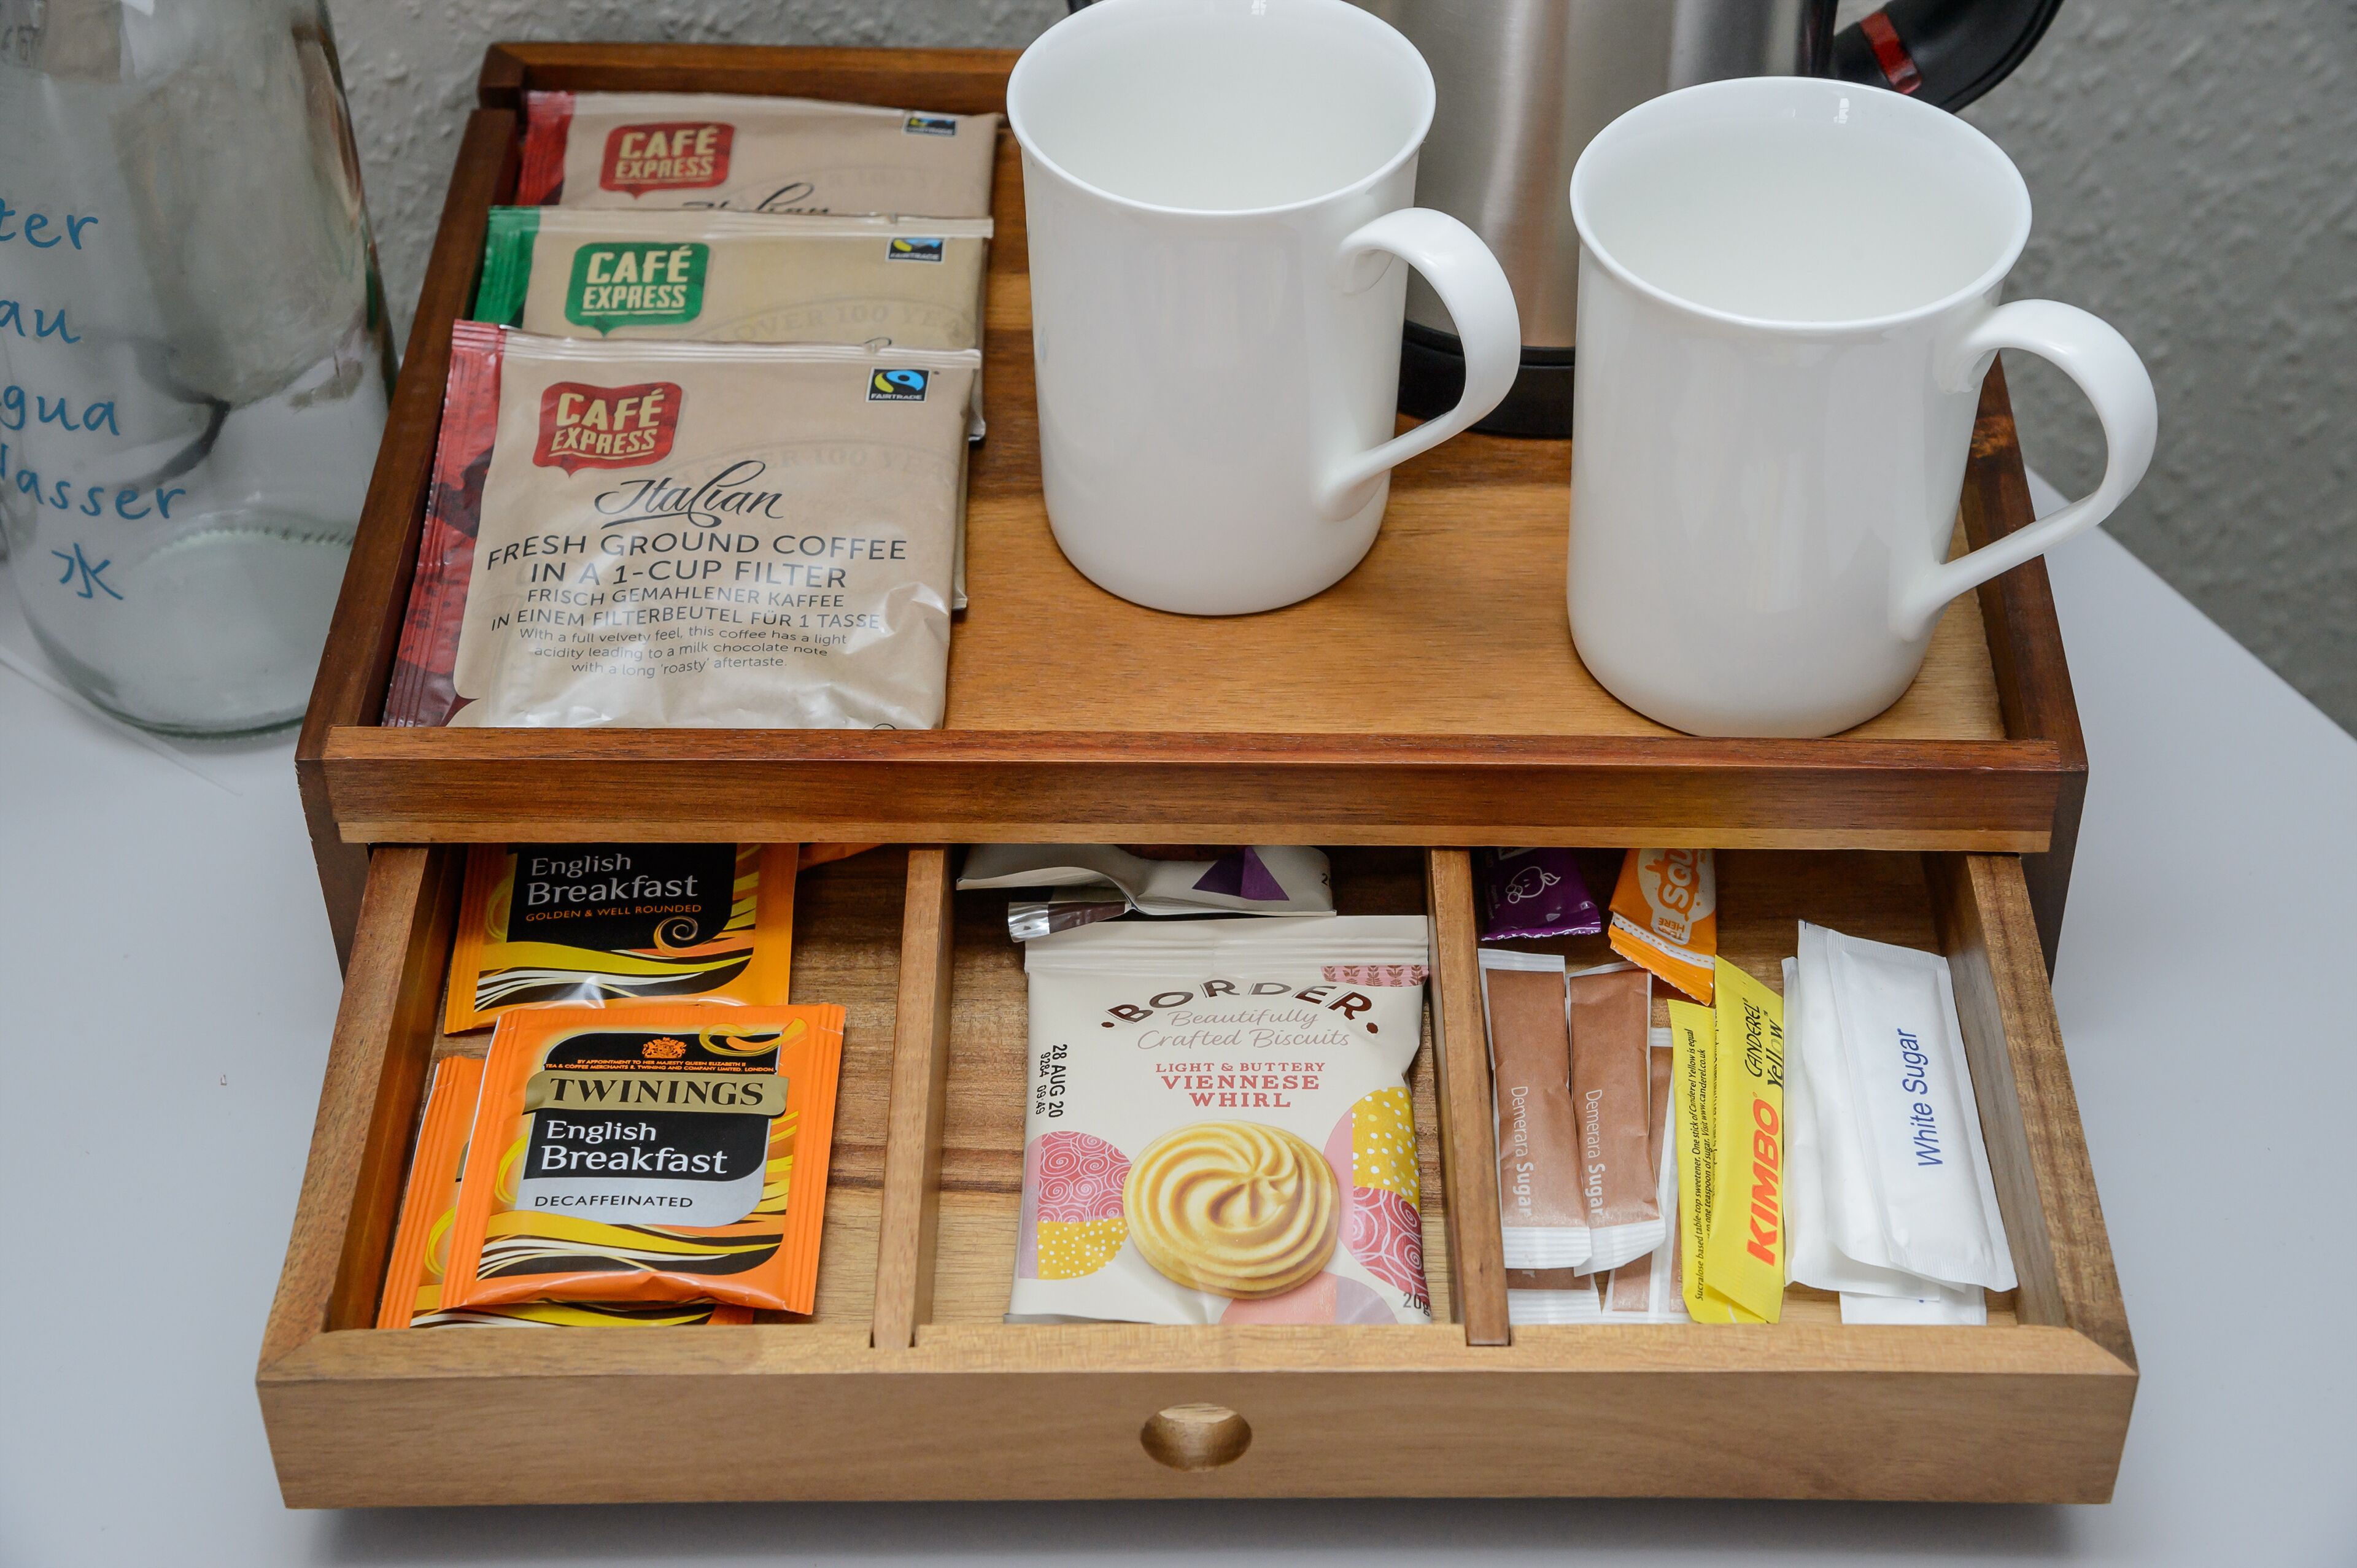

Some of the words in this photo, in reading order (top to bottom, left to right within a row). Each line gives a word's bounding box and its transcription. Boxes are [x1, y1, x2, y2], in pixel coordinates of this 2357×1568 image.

[618, 125, 719, 160] CAFÉ
[614, 155, 714, 179] EXPRESS
[586, 245, 693, 284] CAFÉ
[582, 284, 687, 309] EXPRESS
[556, 388, 665, 431] CAFÉ
[551, 427, 658, 454] EXPRESS
[594, 460, 784, 530] Italian
[487, 535, 587, 571] FRESH
[600, 531, 760, 556] GROUND
[772, 535, 907, 560] COFFEE
[51, 542, 124, 601] 水
[531, 562, 567, 583] IN
[578, 562, 601, 586] A
[613, 559, 723, 585] 1-CUP
[735, 560, 846, 589] FILTER
[527, 589, 605, 606] FRISCH
[611, 586, 761, 604] GEMAHLENER
[768, 591, 845, 608] KAFFEE
[491, 613, 511, 631] IN
[517, 609, 584, 627] EINEM
[592, 606, 743, 627] FILTERBEUTEL
[751, 609, 792, 627] FÜR
[799, 614, 810, 628] 1
[816, 614, 881, 630] TASSE
[520, 627, 554, 641] With
[557, 633, 567, 643] a
[571, 632, 595, 644] full
[598, 632, 651, 644] velvety
[654, 626, 684, 641] feel,
[688, 625, 714, 637] this
[719, 628, 767, 639] coffee
[771, 630, 797, 641] has
[814, 633, 847, 646] light
[534, 646, 584, 660] acidity
[588, 646, 643, 662] leading
[648, 647, 663, 659] to
[667, 647, 675, 657] a
[678, 641, 708, 655] milk
[713, 642, 789, 653] chocolate
[793, 645, 828, 657] note
[571, 662, 604, 674] with
[622, 663, 656, 679] long
[713, 656, 788, 669] aftertaste.
[531, 853, 632, 878] English
[527, 875, 699, 906] Breakfast
[525, 910, 581, 922] GOLDEN
[597, 907, 631, 916] WELL
[635, 904, 702, 914] ROUNDED
[1658, 917, 1686, 933] HERE
[1104, 979, 1374, 1025] BORDER
[1167, 1008, 1318, 1030] Beautifully
[1137, 1029, 1244, 1049] Crafted
[1248, 1028, 1350, 1049] Biscuits
[1684, 1028, 1697, 1046] equal
[1051, 1043, 1068, 1060] 28
[1896, 1027, 1929, 1095] Sugar
[1155, 1062, 1215, 1073] LIGHT
[1221, 1062, 1234, 1072] &
[1239, 1062, 1326, 1072] BUTTERY
[1687, 1054, 1697, 1078] Yellow
[549, 1078, 764, 1106] TWININGS
[1049, 1064, 1067, 1097] AUG
[1161, 1075, 1320, 1090] VIENNESE
[1697, 1049, 1710, 1120] www.canderel.co.uk
[1188, 1092, 1291, 1108] WHIRL
[1687, 1078, 1697, 1113] Canderel
[1048, 1100, 1064, 1118] 20
[1511, 1086, 1529, 1157] Demerara
[1689, 1111, 1699, 1121] of
[545, 1119, 657, 1145] English
[1585, 1089, 1603, 1159] Demerara
[1689, 1120, 1700, 1138] stick
[1701, 1121, 1710, 1137] Visit
[1909, 1102, 1943, 1166] White
[1692, 1138, 1701, 1154] One
[1703, 1138, 1713, 1158] sugar.
[540, 1145, 729, 1174] Breakfast
[1705, 1158, 1712, 1170] of
[1512, 1162, 1534, 1217] Sugar
[1584, 1163, 1606, 1216] Sugar
[1693, 1156, 1702, 1198] sweetener.
[1704, 1172, 1713, 1208] teaspoon
[1746, 1098, 1779, 1267] KIMBO
[534, 1195, 694, 1208] DECAFFEINATED
[1693, 1197, 1703, 1235] table-top
[1695, 1235, 1704, 1260] based
[1694, 1261, 1705, 1301] Sucralose
[1403, 1291, 1431, 1317] 20g
